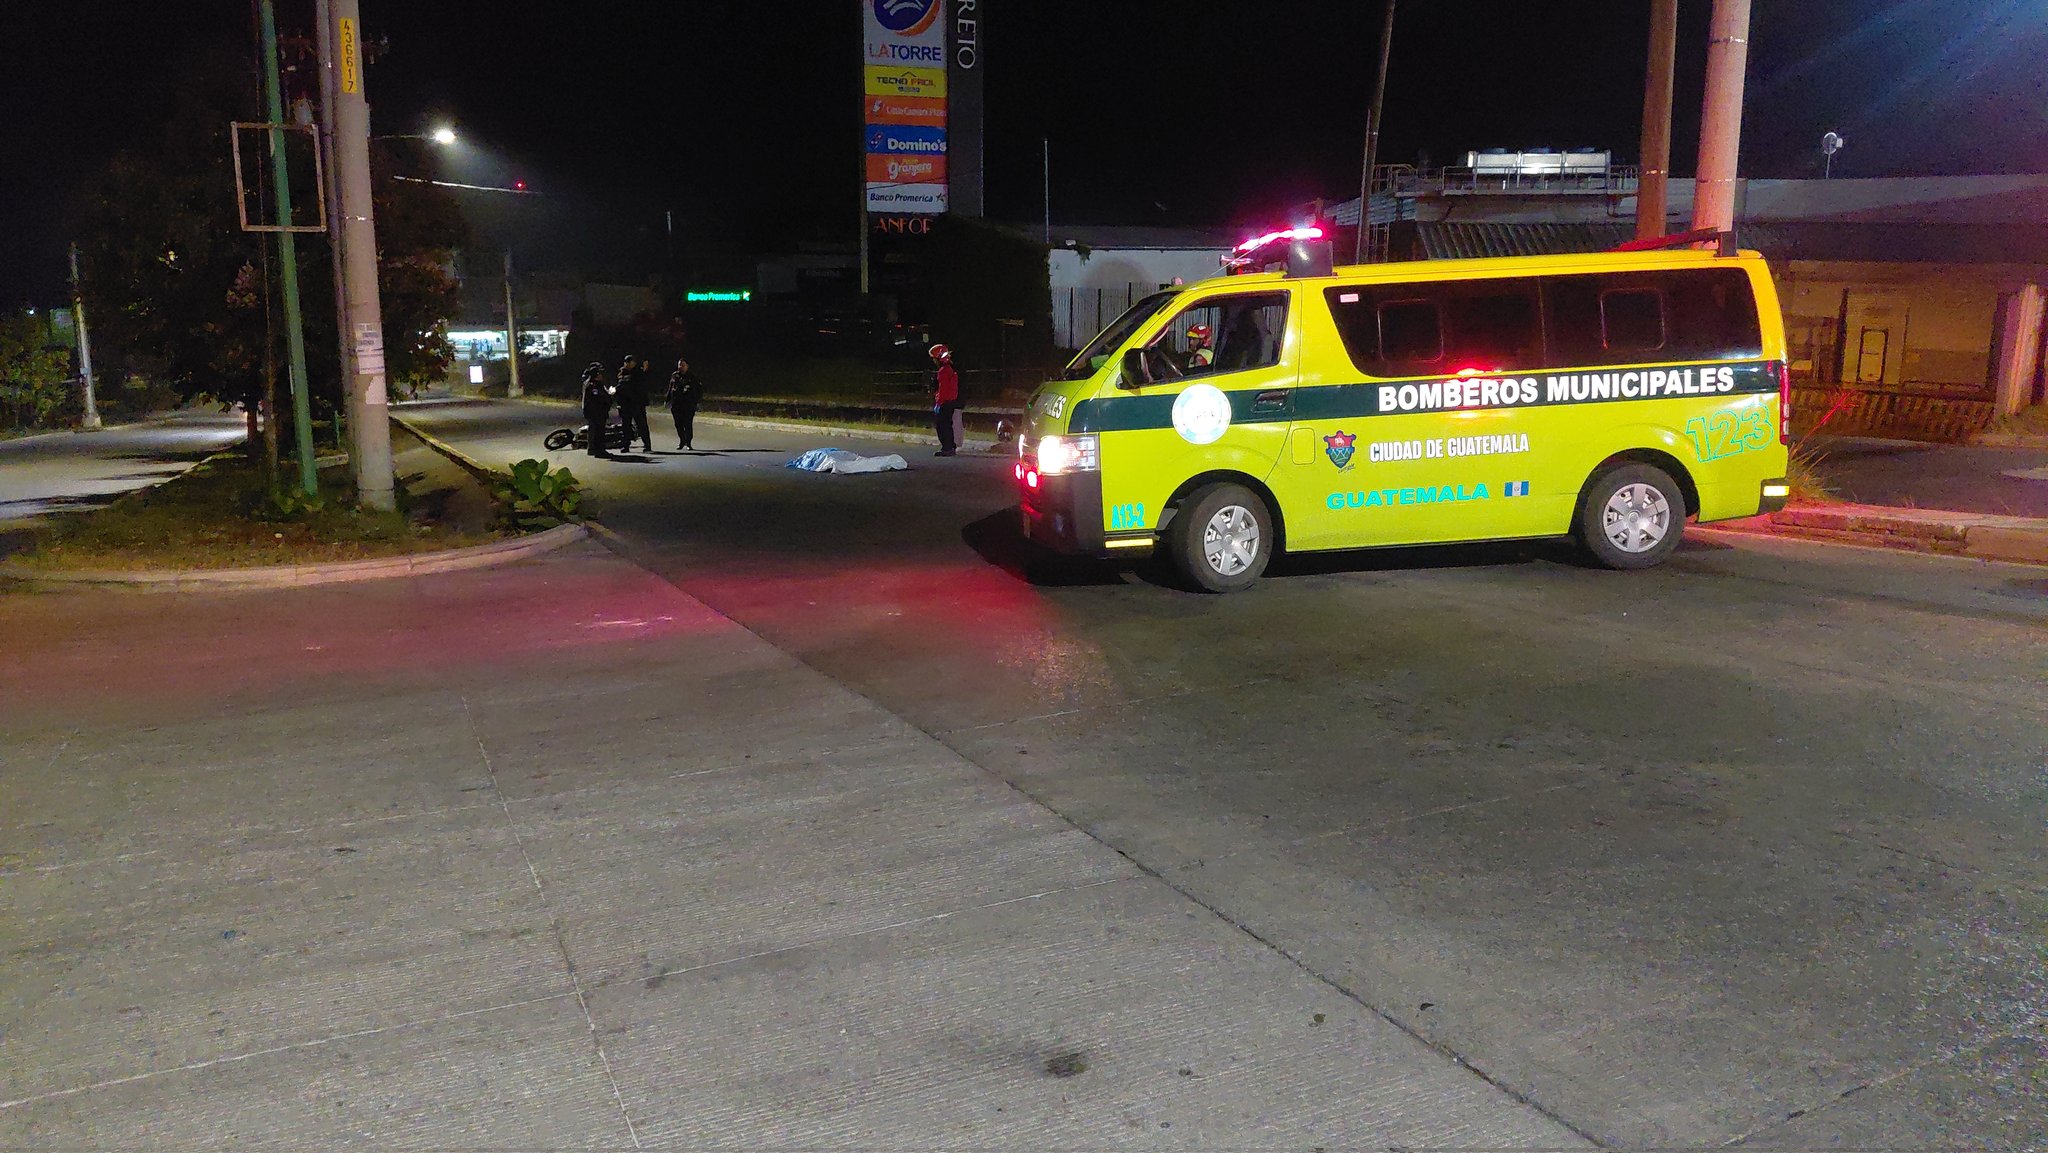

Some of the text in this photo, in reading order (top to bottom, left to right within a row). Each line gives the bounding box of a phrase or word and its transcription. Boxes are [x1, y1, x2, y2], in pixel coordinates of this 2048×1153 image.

[344, 20, 354, 92] 436617
[887, 137, 947, 152] Domino's
[870, 192, 934, 203] Banco Promerica
[1378, 366, 1734, 412] BOMBEROS MUNICIPALES
[1686, 402, 1775, 463] 123
[1369, 433, 1530, 463] CIUDAD DE GUATEMALA
[1326, 482, 1490, 510] GUATEMALA
[1111, 502, 1145, 529] A13-2
